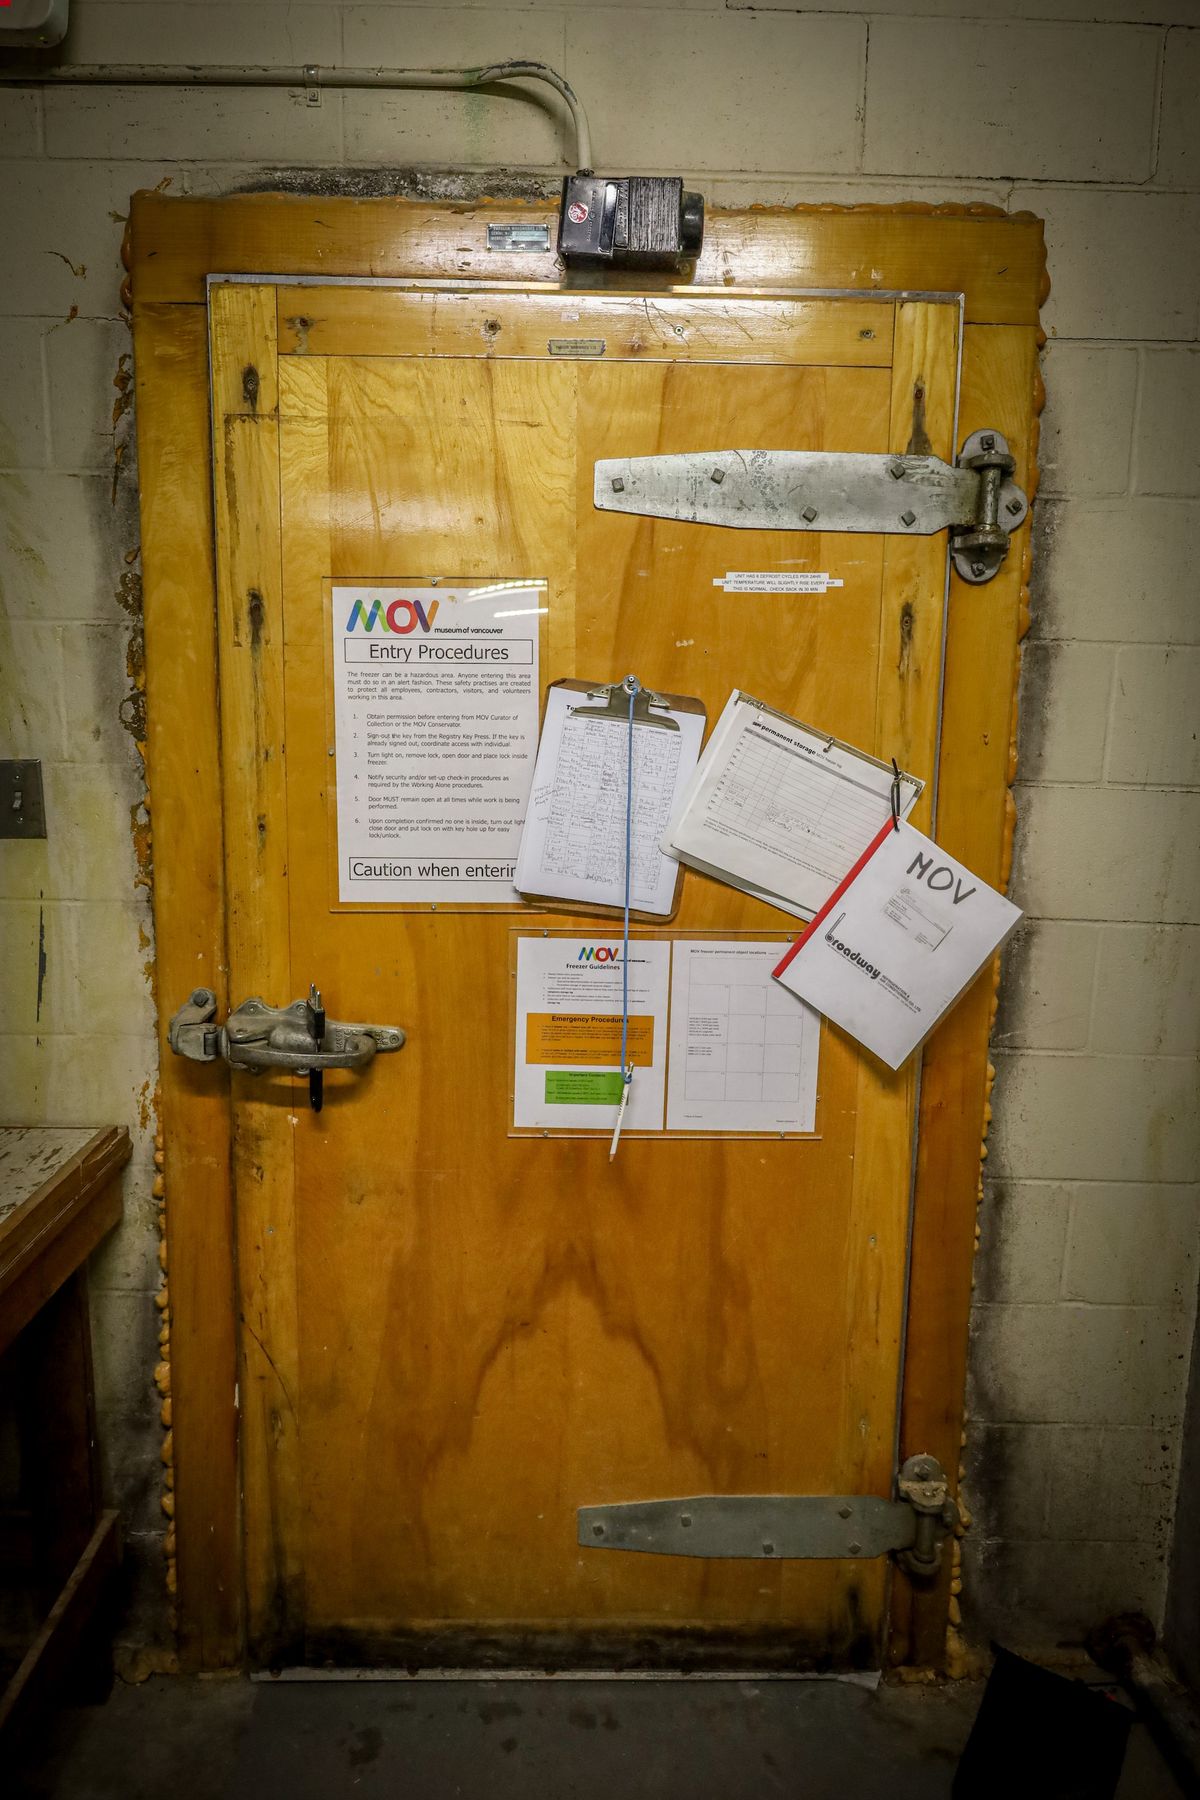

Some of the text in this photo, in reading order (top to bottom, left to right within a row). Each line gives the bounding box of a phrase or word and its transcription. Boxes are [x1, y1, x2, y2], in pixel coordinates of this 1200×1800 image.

[346, 600, 440, 634] MOV
[370, 644, 509, 662] Entry Procedures
[761, 725, 816, 754] permanent storage
[353, 863, 412, 876] Caution
[418, 863, 459, 877] when
[906, 852, 976, 904] MOV
[578, 947, 618, 962] MOV
[825, 913, 880, 980] broadway
